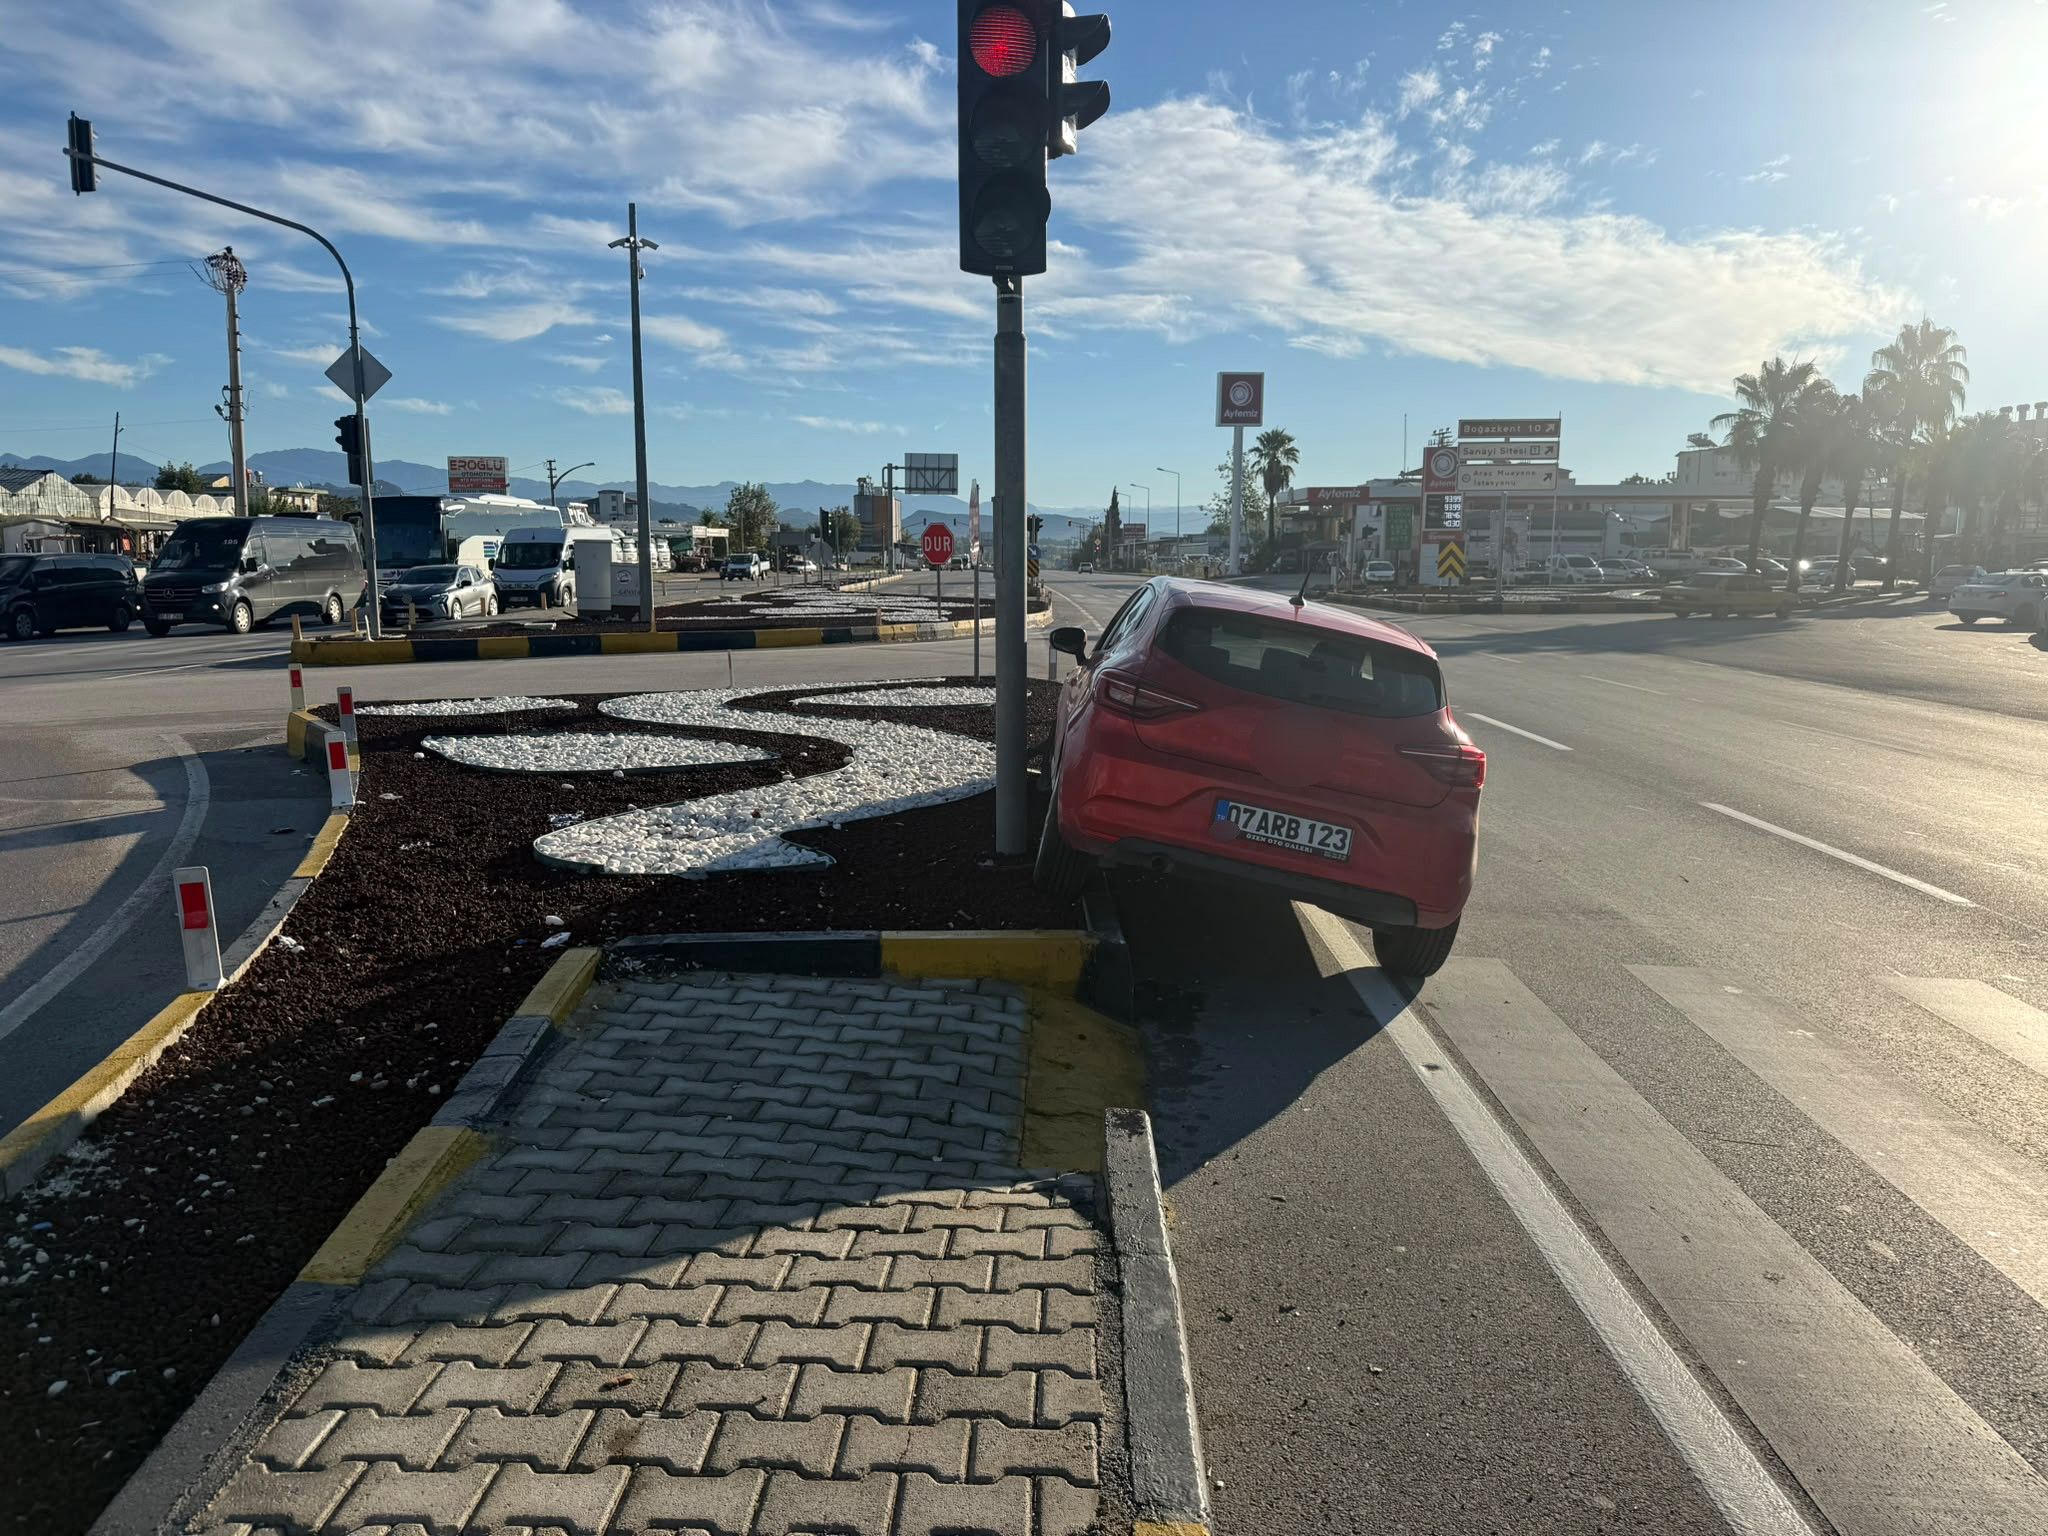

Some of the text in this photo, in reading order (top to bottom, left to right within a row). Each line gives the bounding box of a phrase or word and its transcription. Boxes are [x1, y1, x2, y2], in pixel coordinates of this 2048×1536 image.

[1224, 409, 1258, 419] Aytemiz
[1463, 424, 1541, 434] Boğazkent 10
[1463, 447, 1527, 456] Sanayi Sitesi
[1318, 488, 1361, 500] Aytemiz
[924, 536, 951, 551] DUR
[1308, 823, 1348, 850] 123
